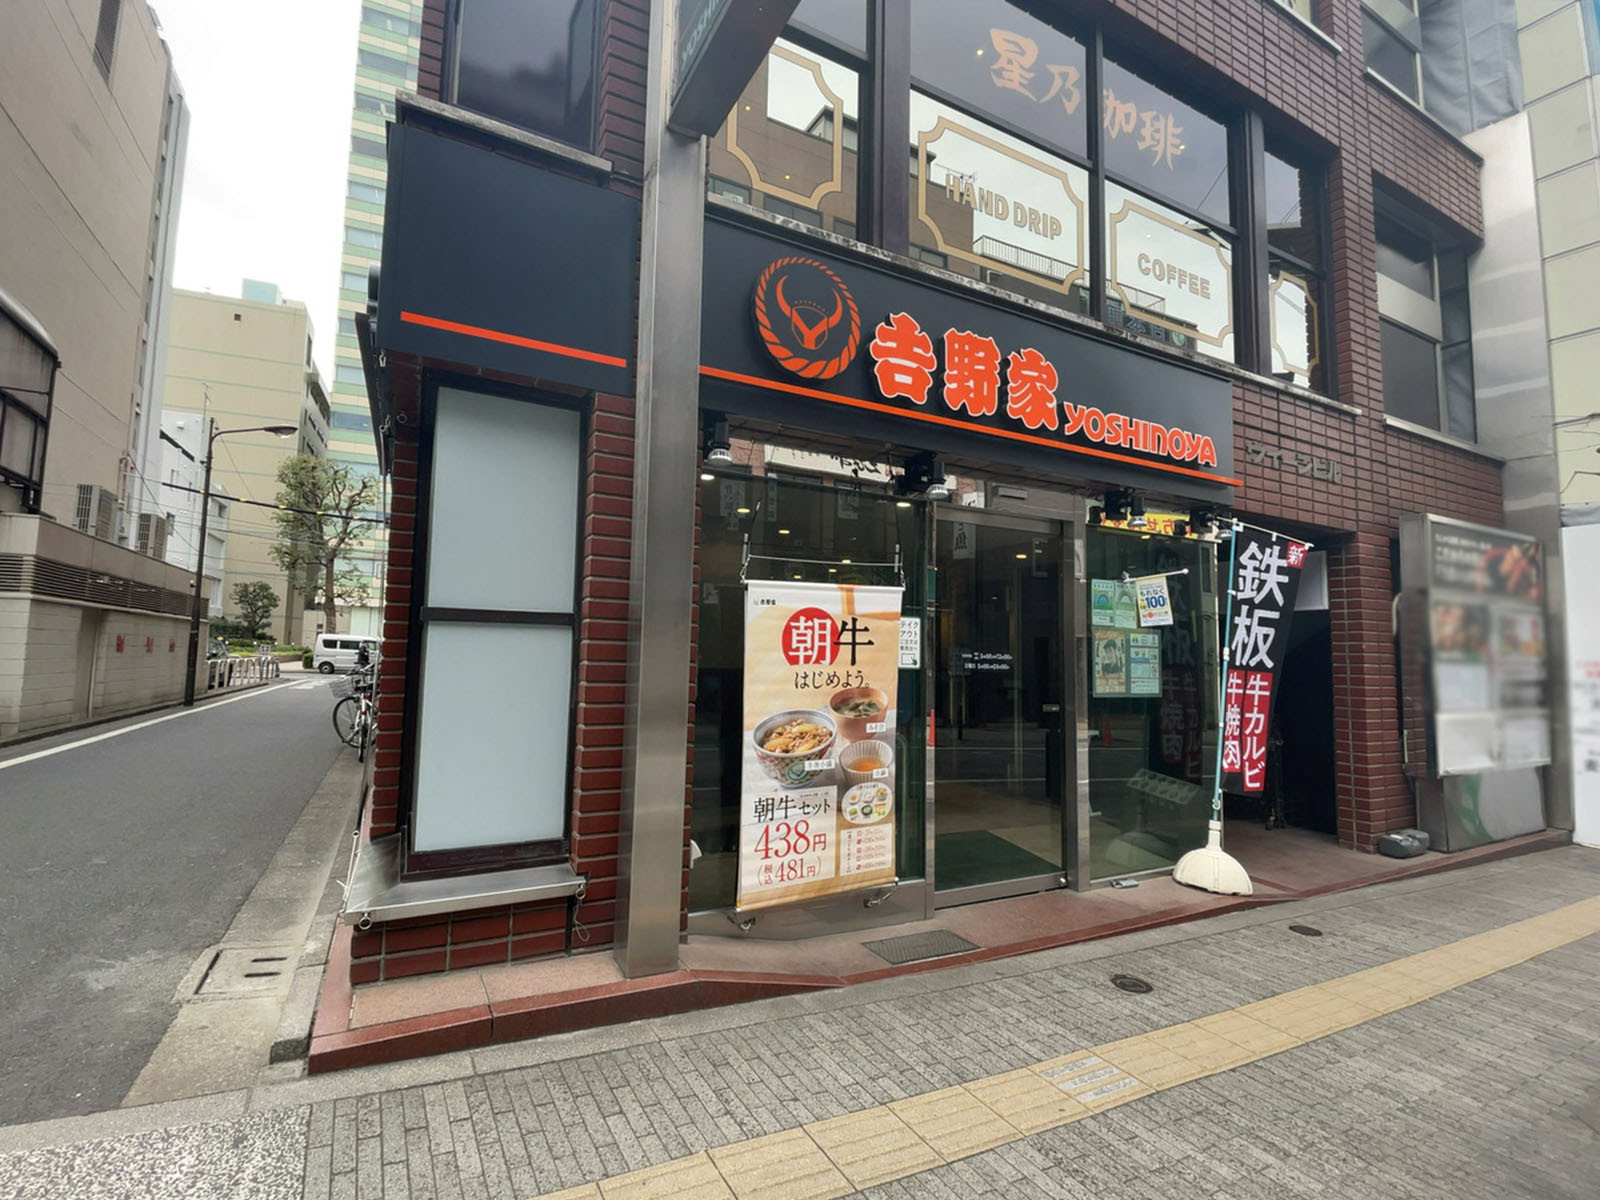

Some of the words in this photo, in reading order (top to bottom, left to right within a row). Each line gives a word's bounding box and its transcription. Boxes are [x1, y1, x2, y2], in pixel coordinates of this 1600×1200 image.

[945, 173, 1009, 221] HAND
[1013, 201, 1062, 240] DRIP
[1137, 253, 1211, 299] COFFEE
[1063, 401, 1217, 467] YOSHINOYA
[1287, 545, 1303, 566] 新
[1231, 541, 1289, 669] 鉄板
[788, 616, 874, 666] 朝牛
[795, 670, 870, 689] はじめよう。
[1222, 671, 1243, 769] 牛焼肉
[1243, 673, 1270, 788] 牛カルビ
[753, 795, 831, 823] 朝牛セット
[754, 819, 827, 860] 438円
